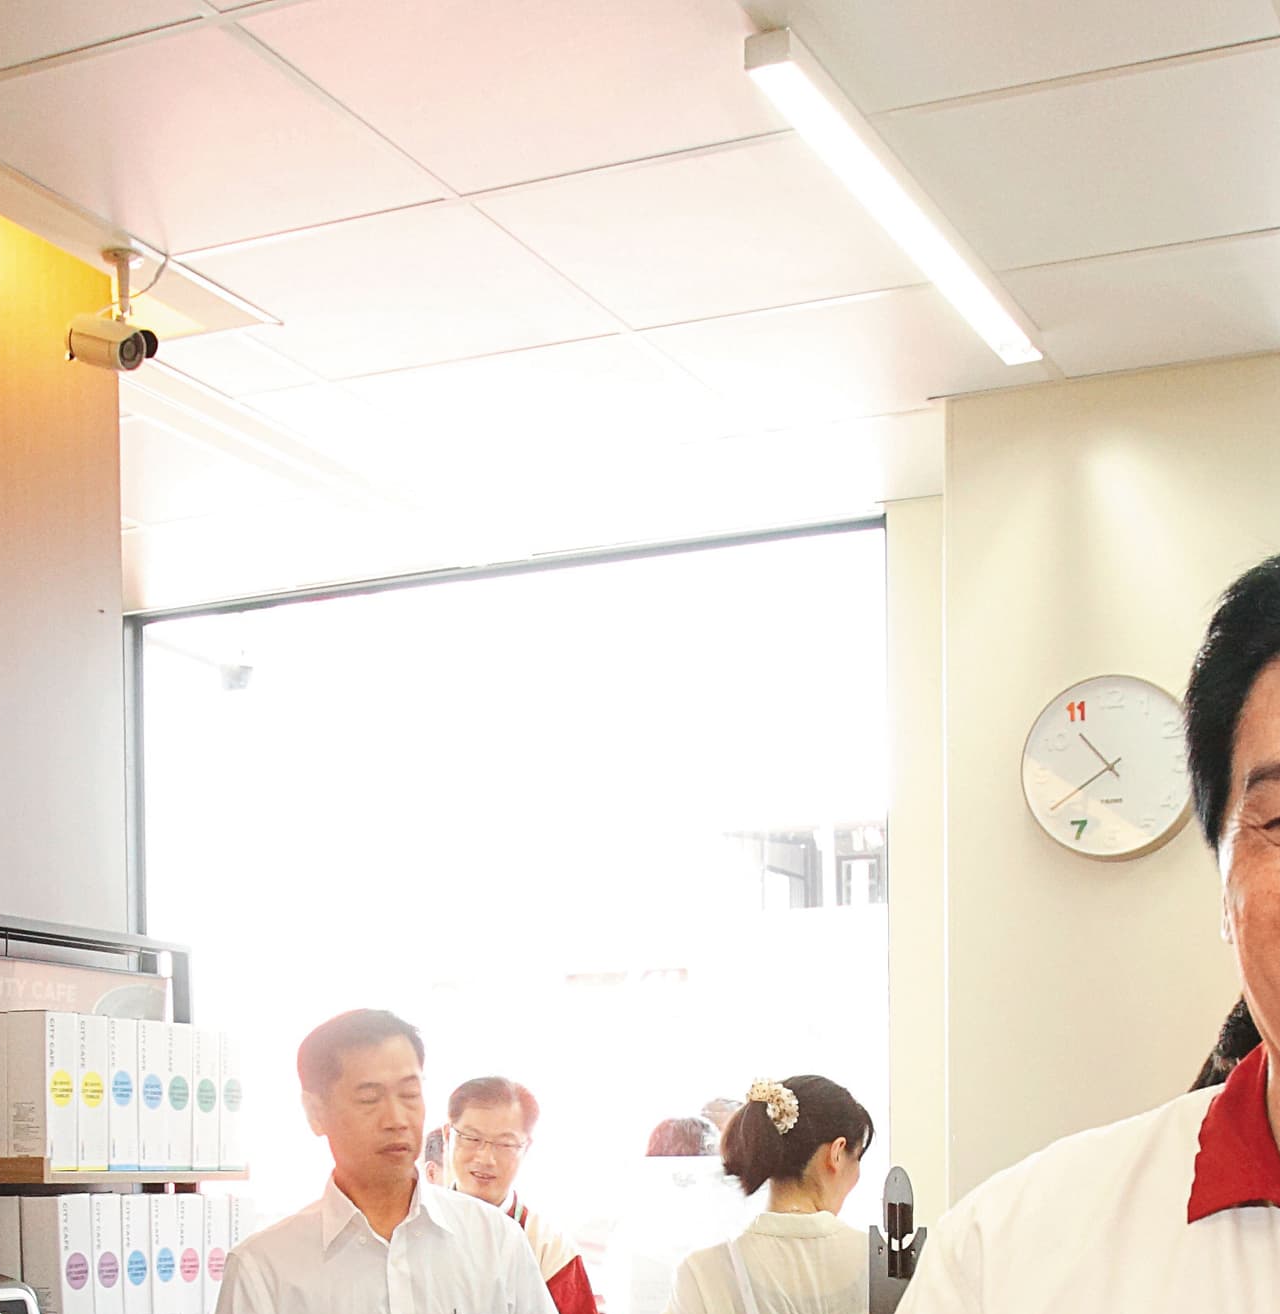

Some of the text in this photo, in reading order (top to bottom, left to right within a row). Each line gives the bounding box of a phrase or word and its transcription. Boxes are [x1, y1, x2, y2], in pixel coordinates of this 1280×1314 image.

[1066, 700, 1086, 722] 11
[1070, 819, 1088, 840] 7
[31, 979, 78, 1002] CAFE
